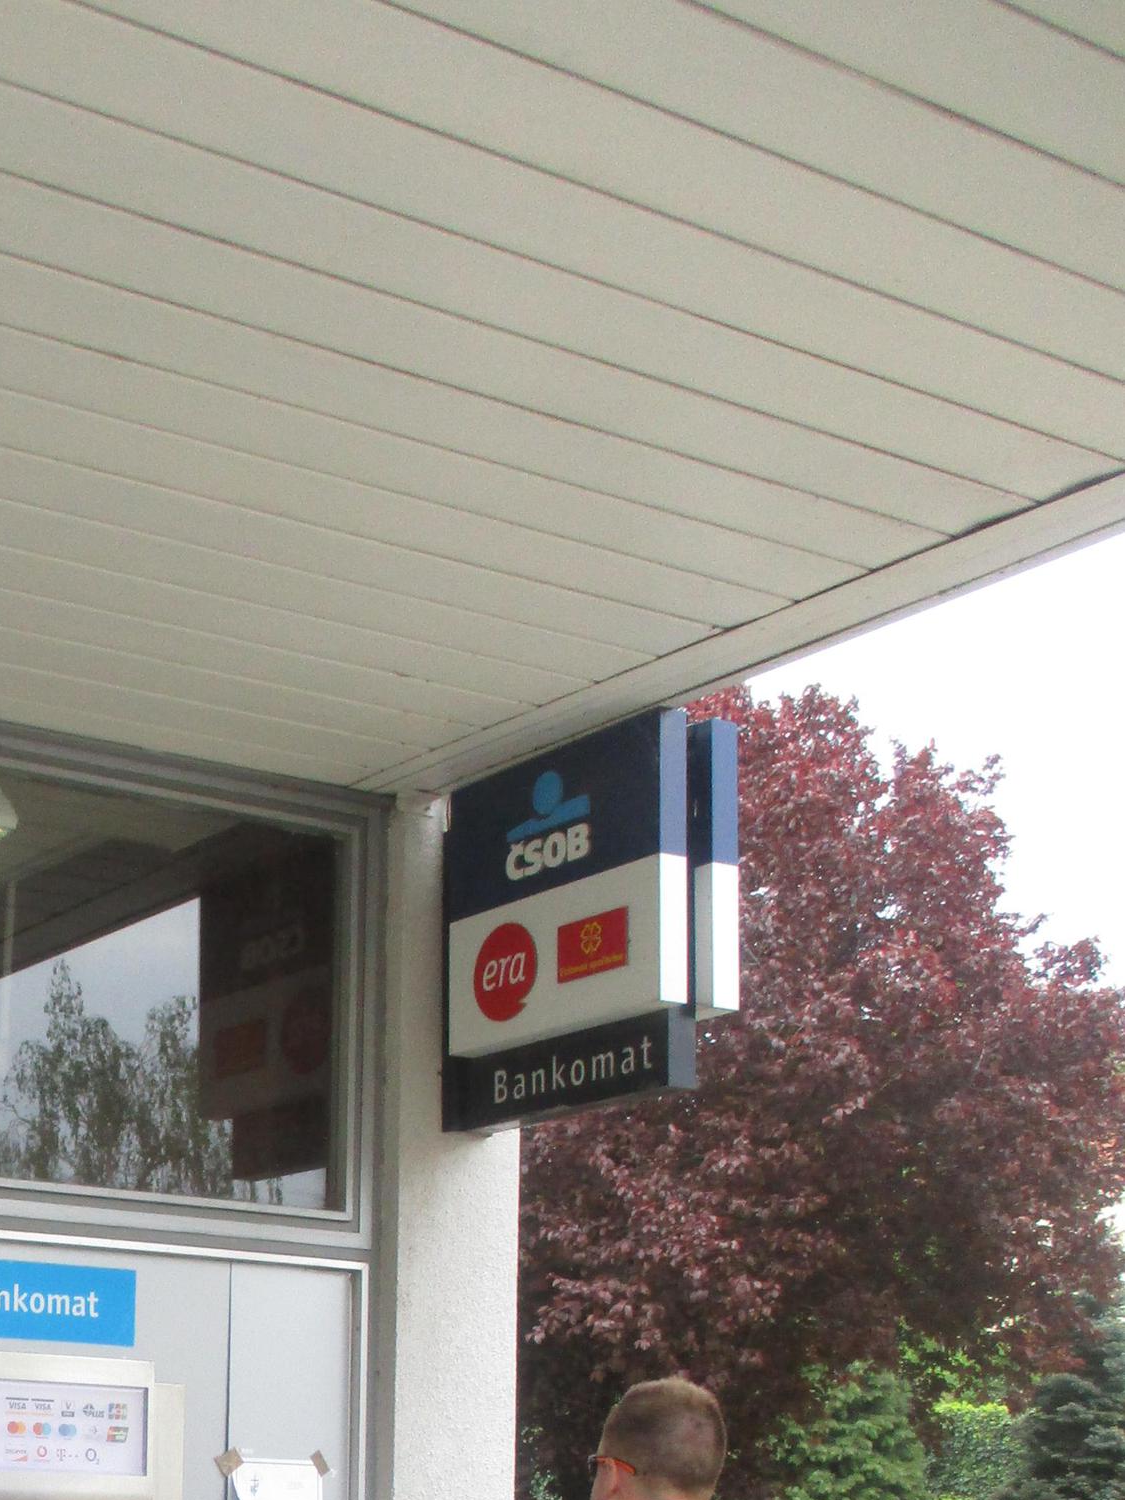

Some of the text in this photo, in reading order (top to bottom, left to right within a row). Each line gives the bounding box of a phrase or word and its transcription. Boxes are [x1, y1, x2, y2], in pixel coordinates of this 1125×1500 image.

[505, 821, 592, 881] ČSOB
[482, 951, 526, 992] era
[493, 1034, 654, 1104] Bankomat
[9, 1401, 27, 1410] VISA
